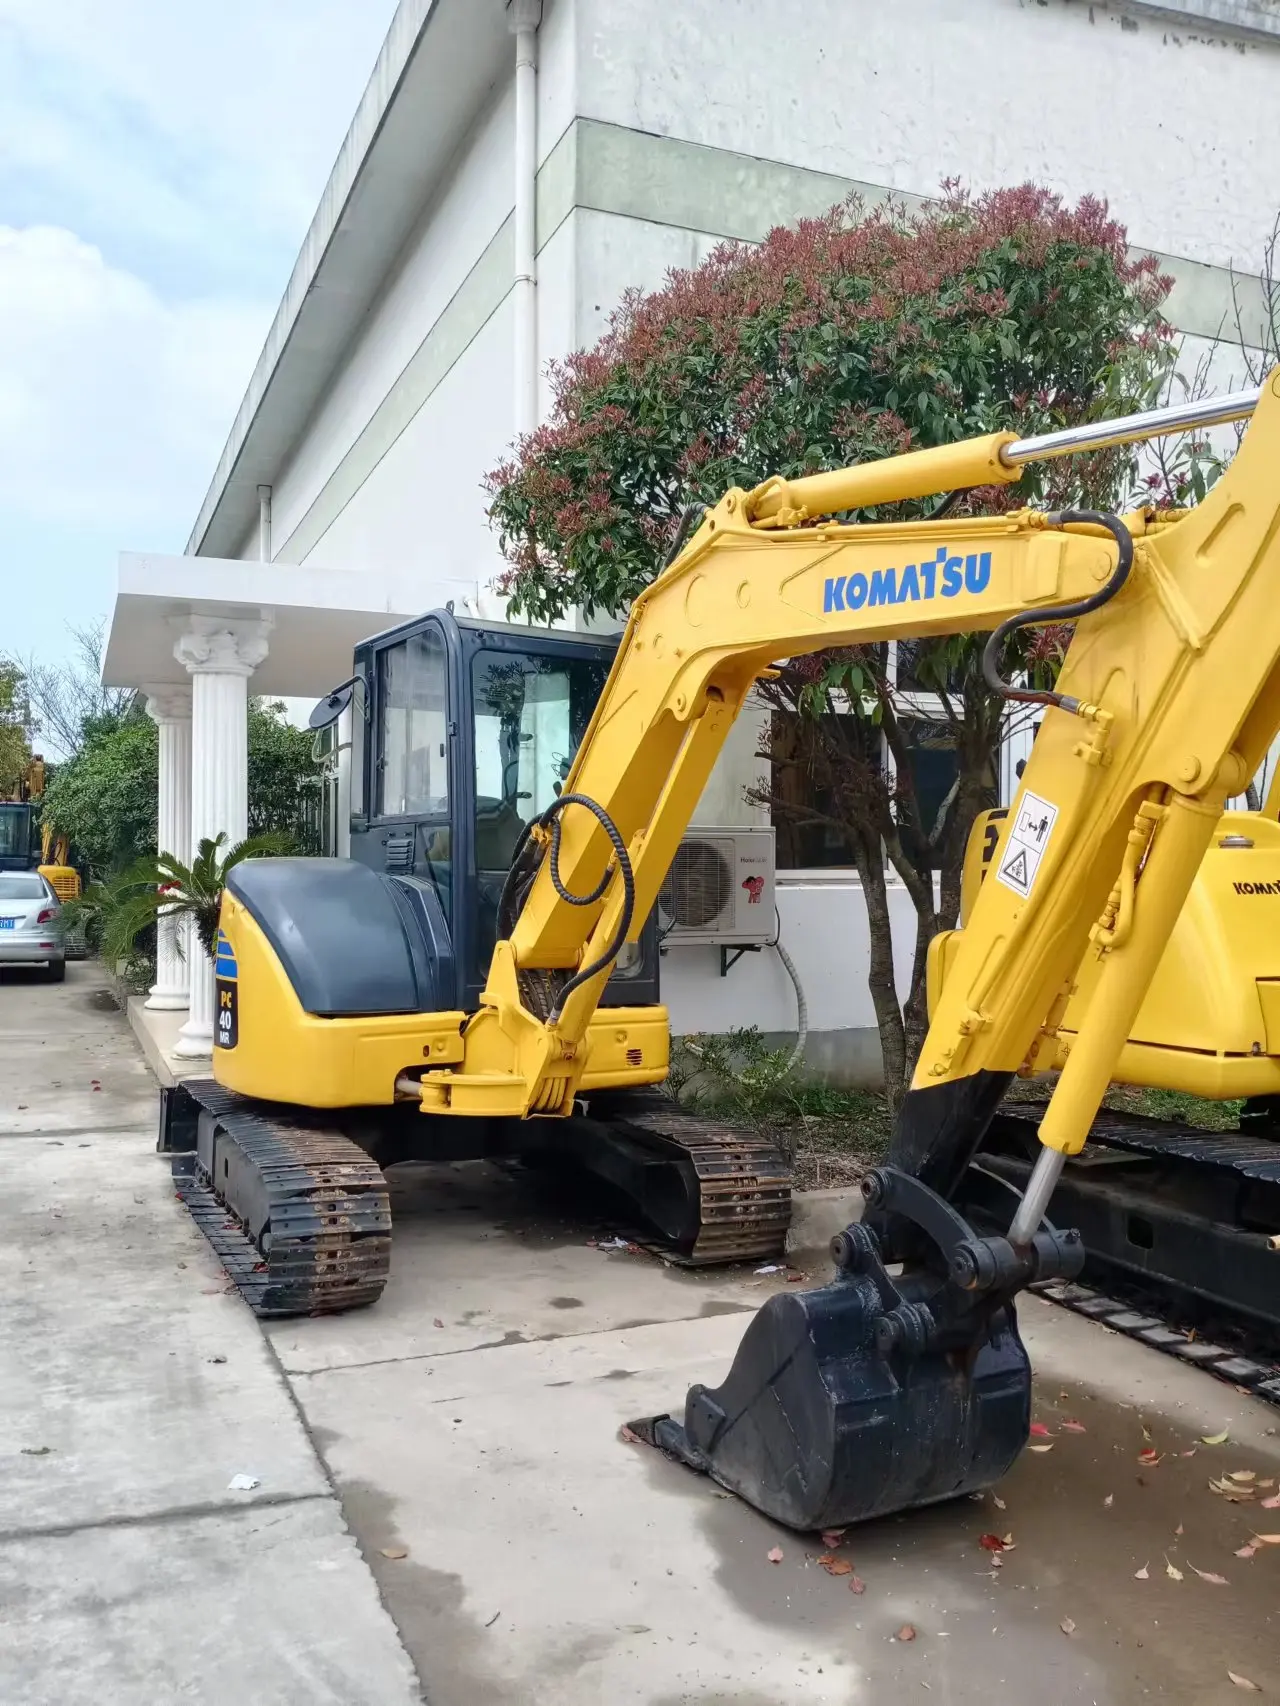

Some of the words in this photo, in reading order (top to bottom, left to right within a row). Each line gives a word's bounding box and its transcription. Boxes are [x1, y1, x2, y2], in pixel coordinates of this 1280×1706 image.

[823, 546, 992, 613] KOMATSU
[220, 990, 232, 1008] PC
[219, 1010, 232, 1030] 40
[219, 1030, 230, 1044] MR
